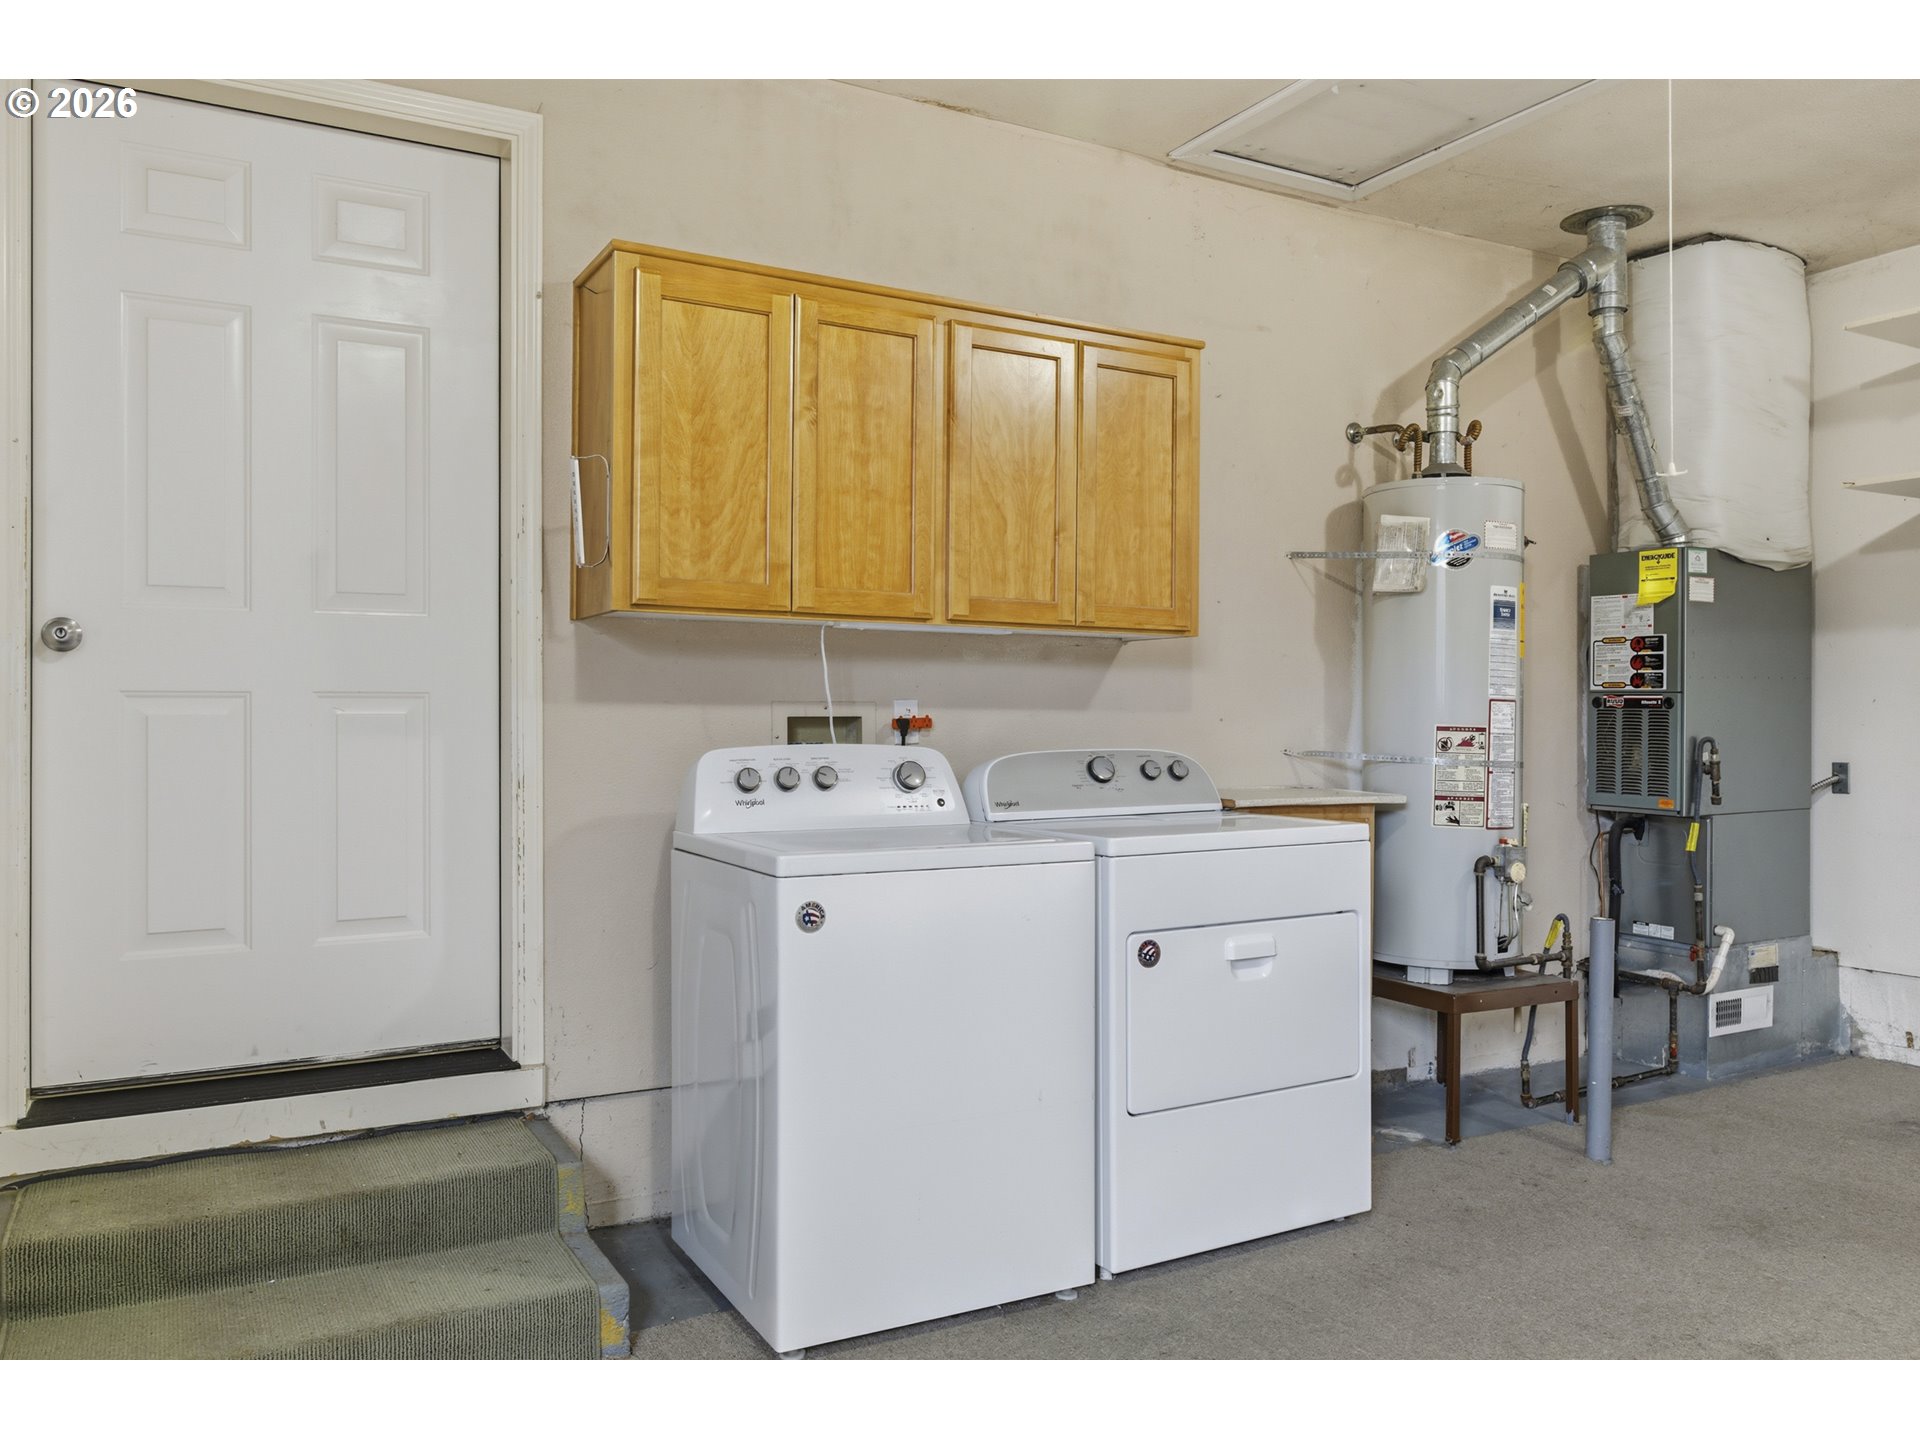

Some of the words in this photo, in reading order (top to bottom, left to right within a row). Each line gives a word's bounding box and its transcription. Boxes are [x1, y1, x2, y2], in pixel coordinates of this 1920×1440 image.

[734, 798, 765, 809] Whirlpool
[994, 799, 1020, 810] Whirlpool
[800, 901, 825, 920] AMERICA
